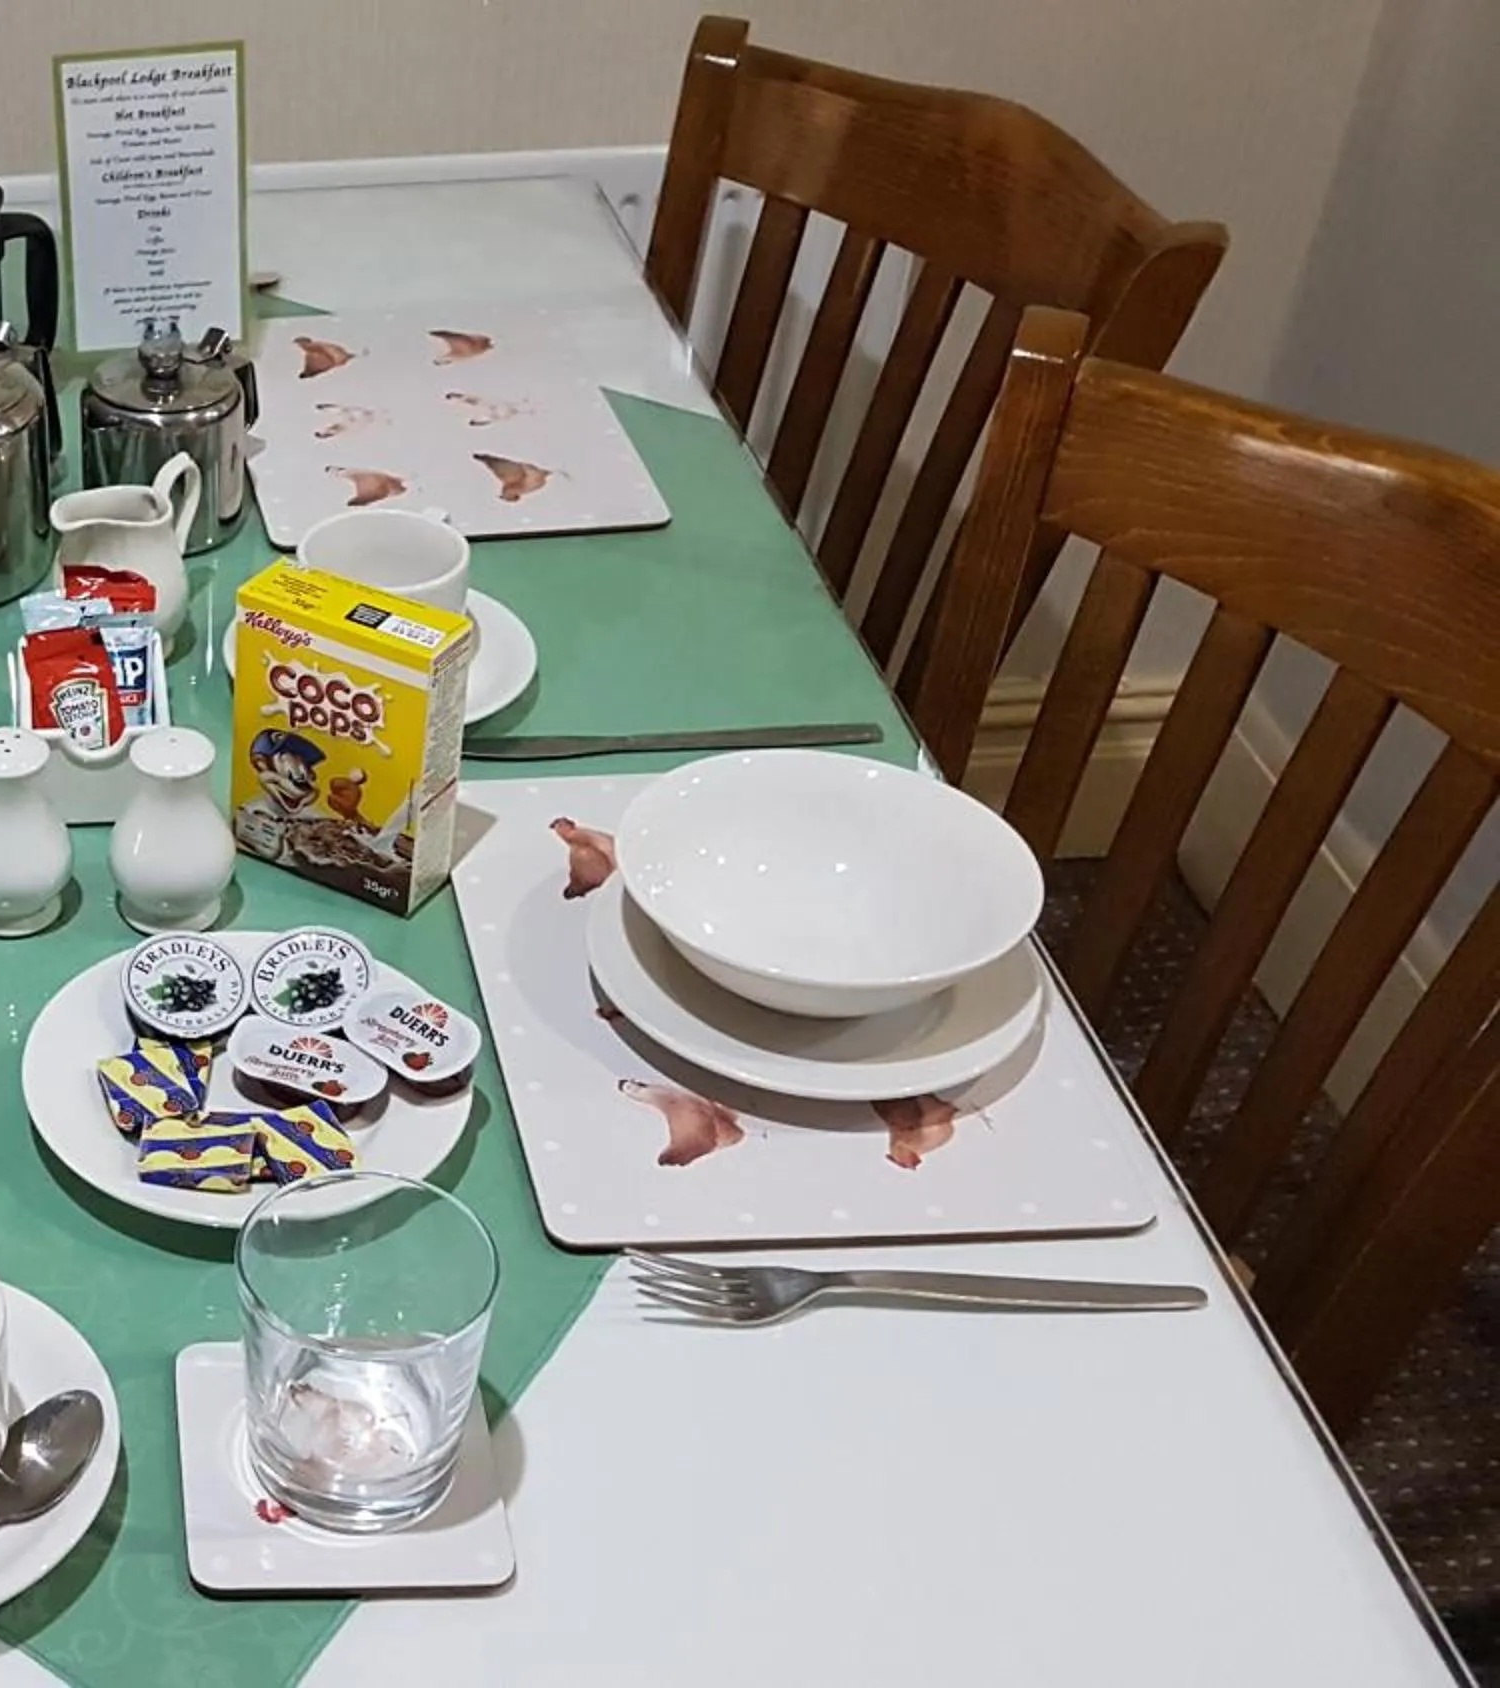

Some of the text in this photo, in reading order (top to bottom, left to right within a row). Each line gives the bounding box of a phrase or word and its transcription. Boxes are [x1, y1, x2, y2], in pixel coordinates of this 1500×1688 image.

[65, 64, 233, 90] Blackpool Lodge Breakfast
[115, 105, 186, 121] Hot Breakfast
[101, 163, 203, 184] Children's Breakfast
[137, 206, 172, 220] Drinks
[244, 610, 315, 648] Kellogg's
[58, 686, 90, 700] HEINZ
[60, 699, 99, 715] TOMATO
[388, 1005, 450, 1048] DUERR'S
[268, 1043, 347, 1074] DUERR'S
